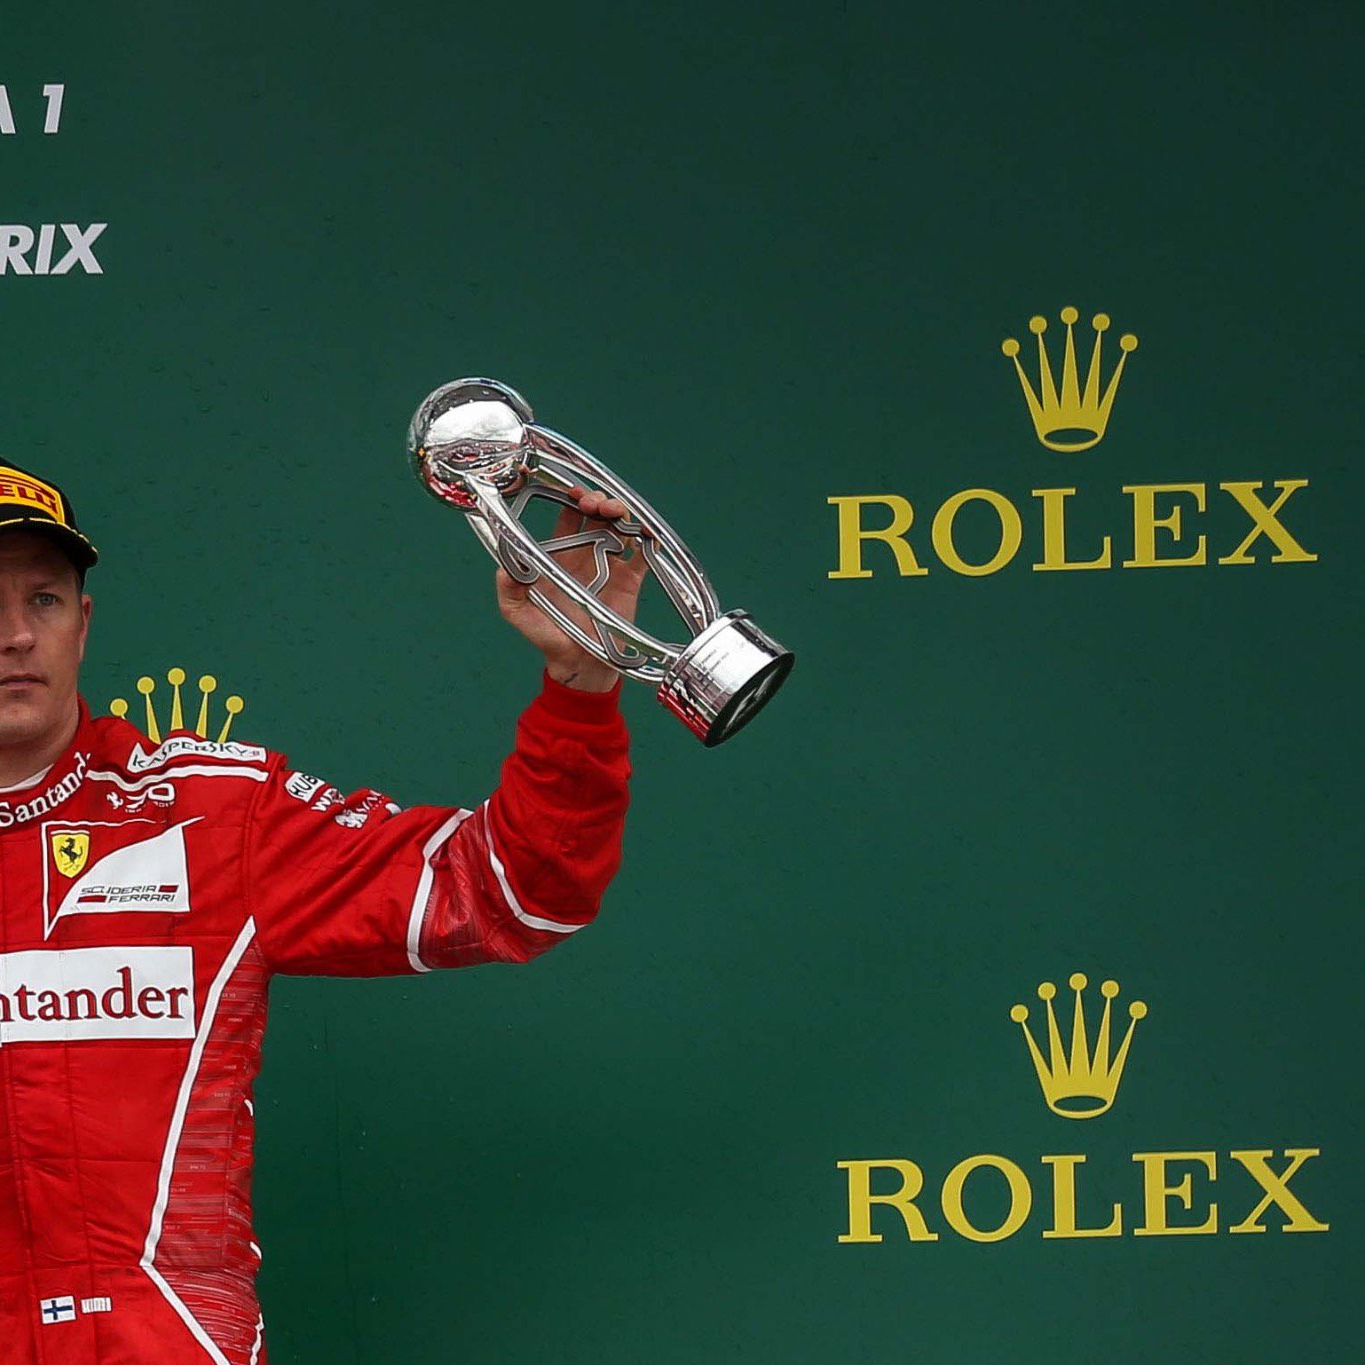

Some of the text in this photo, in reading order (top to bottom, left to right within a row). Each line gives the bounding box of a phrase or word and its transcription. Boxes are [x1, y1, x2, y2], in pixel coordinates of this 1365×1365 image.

[41, 83, 66, 134] 1
[828, 479, 1318, 579] ROLEX
[107, 893, 176, 904] FERRARI
[839, 1148, 1328, 1243] ROLEX
